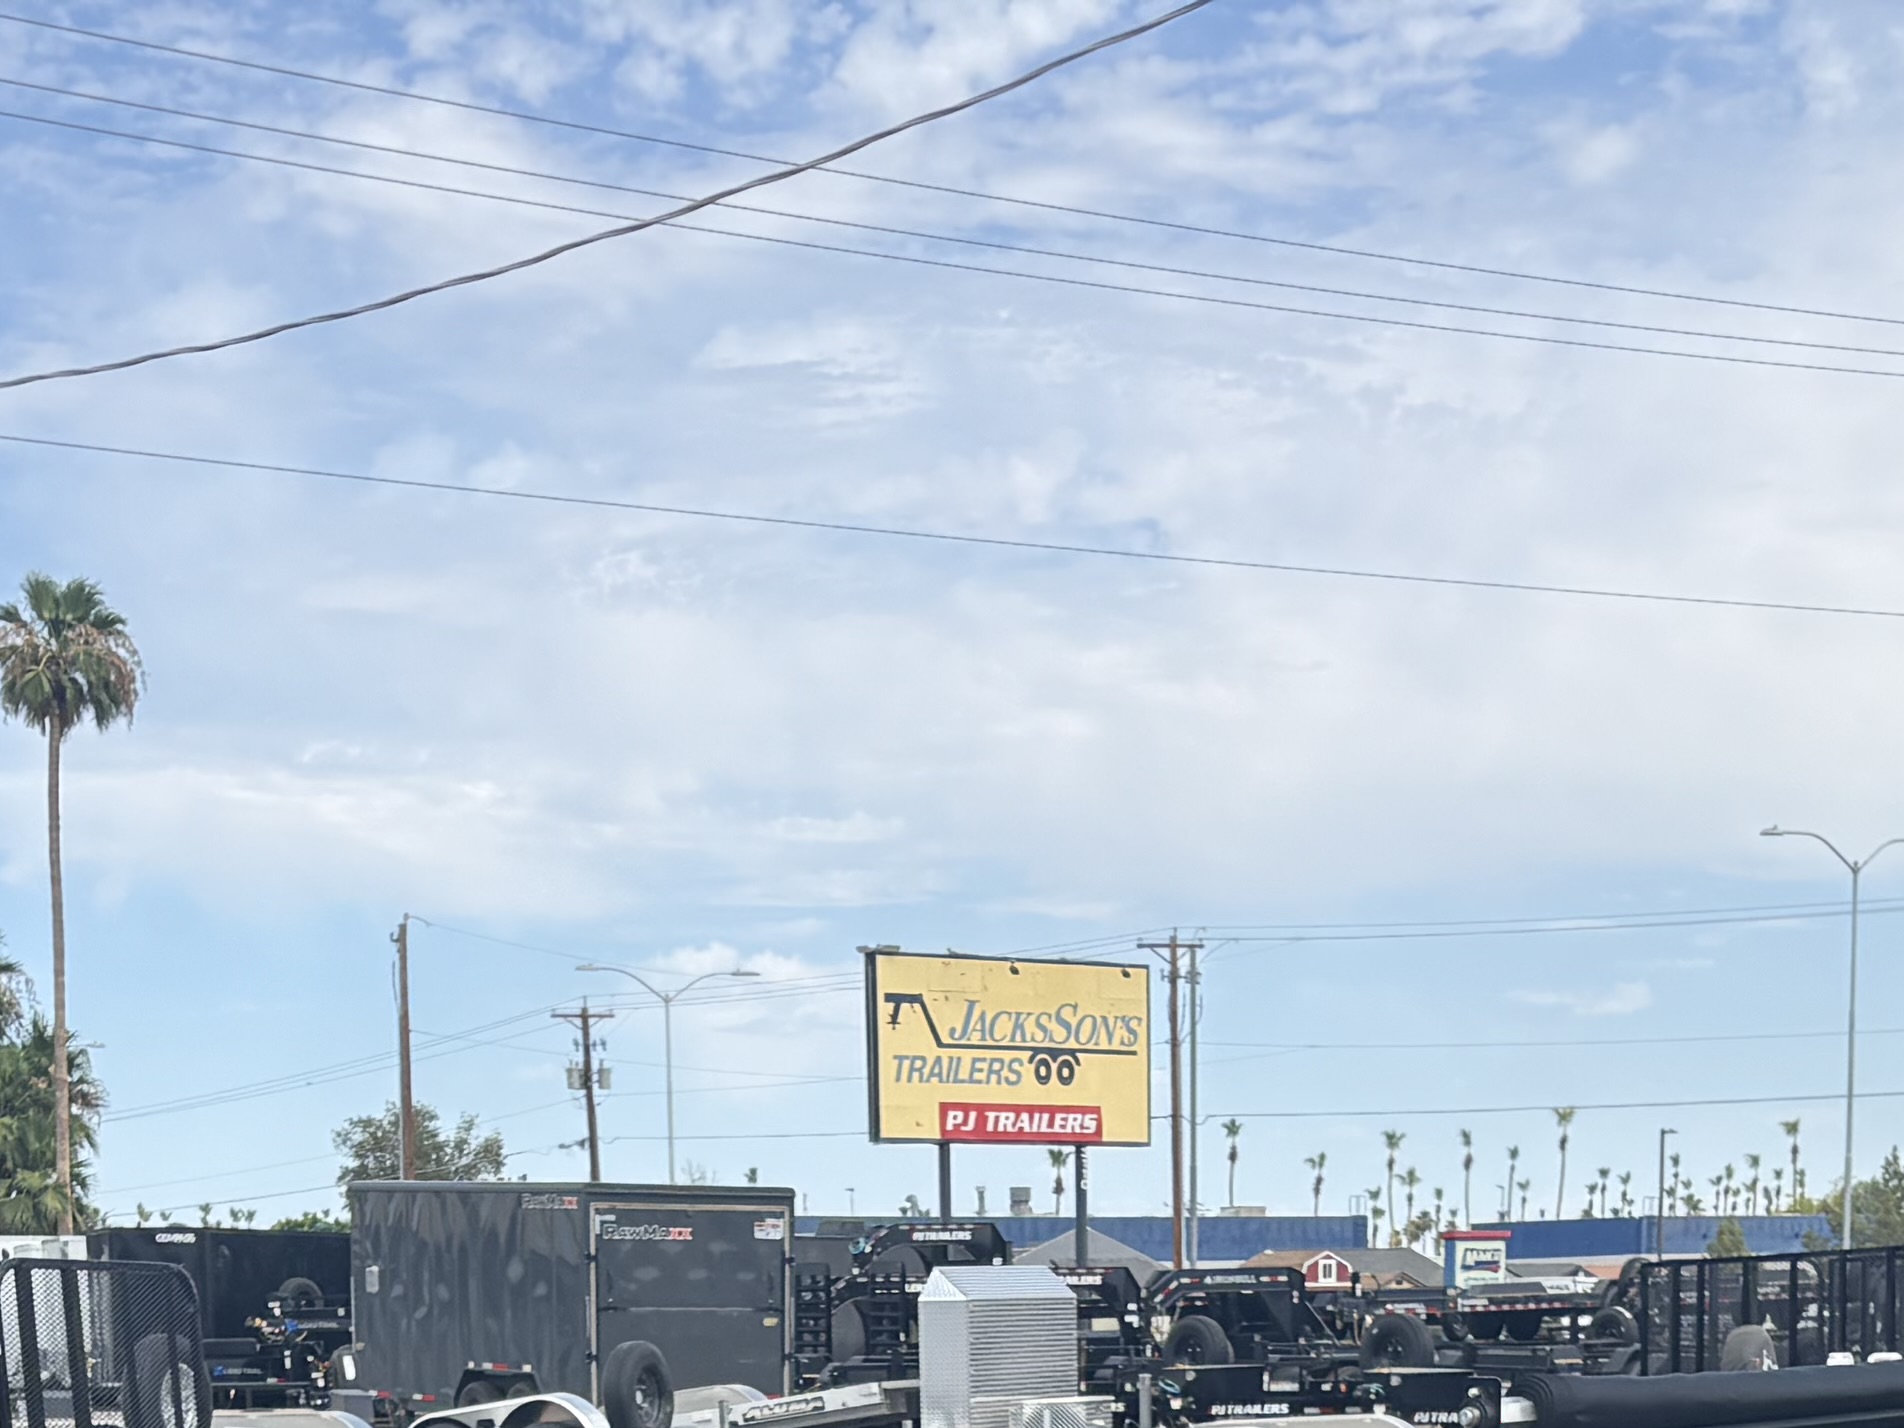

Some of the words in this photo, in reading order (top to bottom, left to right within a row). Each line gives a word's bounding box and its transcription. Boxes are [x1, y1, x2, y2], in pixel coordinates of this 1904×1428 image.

[893, 1055, 1026, 1086] TRAILERS
[946, 1110, 977, 1131] PJ
[985, 1111, 1098, 1134] TRAILERS
